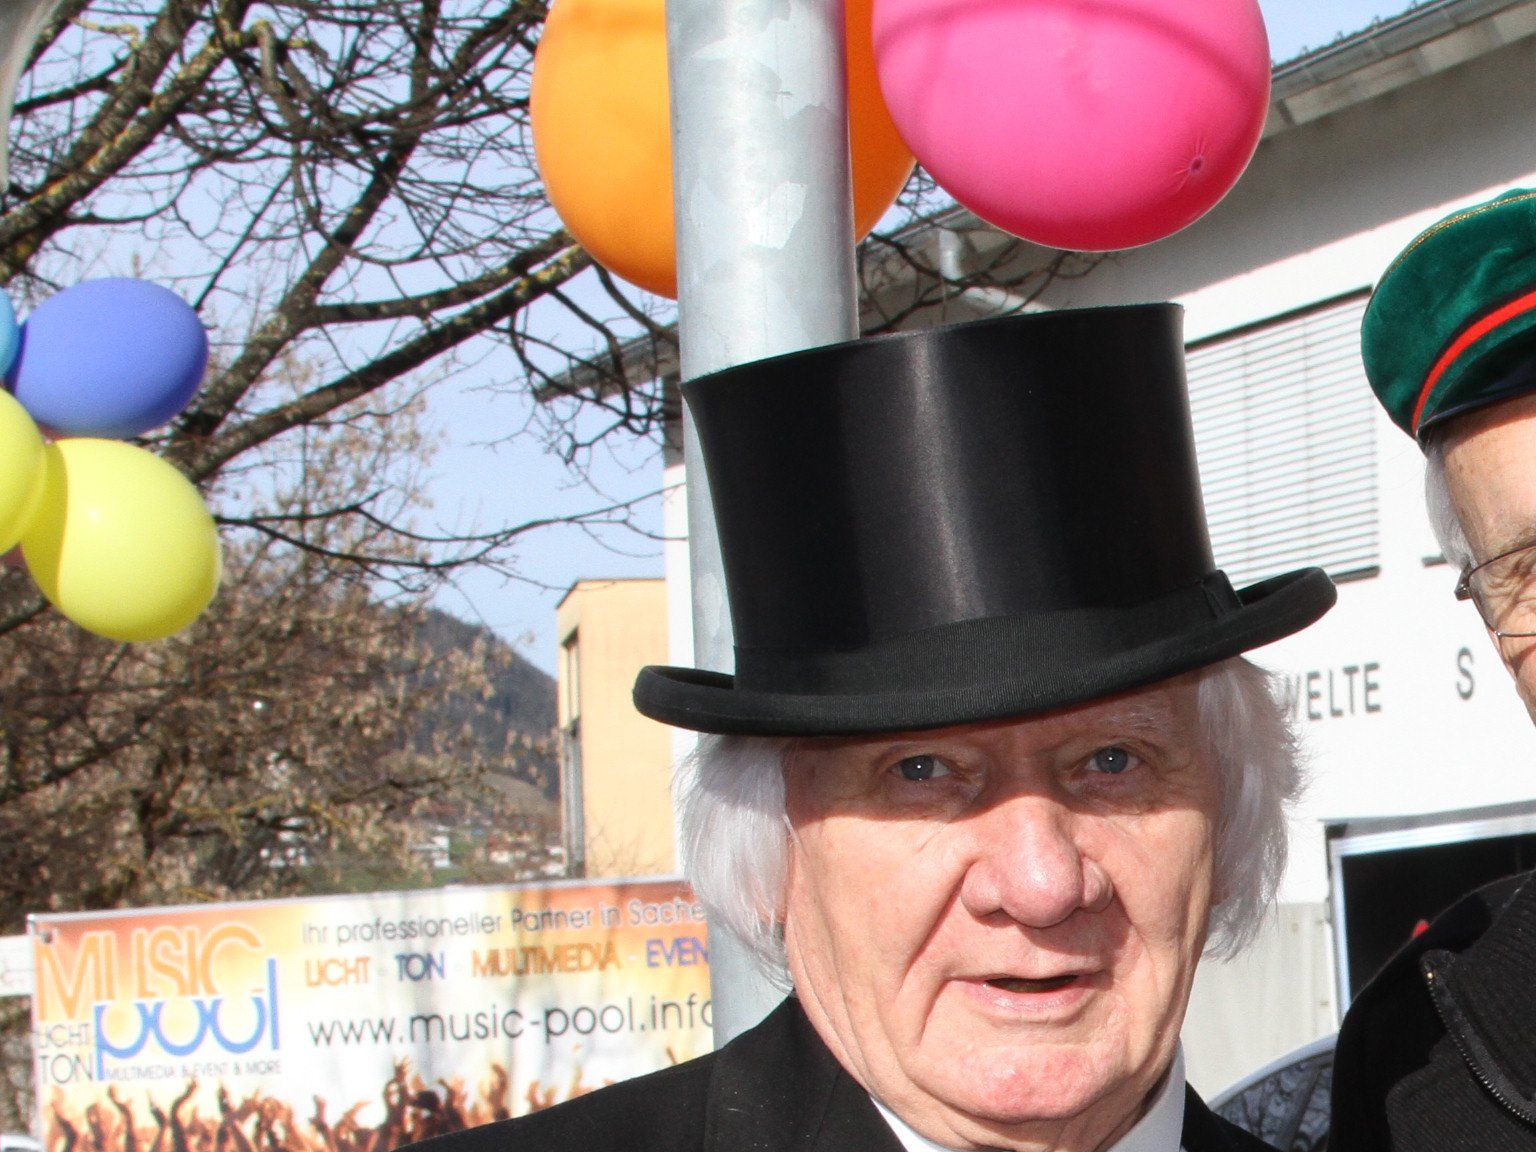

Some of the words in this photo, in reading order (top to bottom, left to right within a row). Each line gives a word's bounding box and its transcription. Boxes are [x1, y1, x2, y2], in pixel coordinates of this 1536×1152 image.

[337, 912, 502, 947] professioneller
[511, 908, 593, 932] Partner
[34, 923, 264, 1021] MUSIC
[304, 956, 371, 988] LICHT
[395, 952, 446, 982] TON
[471, 939, 622, 978] MULTIMEDIA
[93, 957, 281, 1082] pool
[38, 1053, 94, 1084] TON
